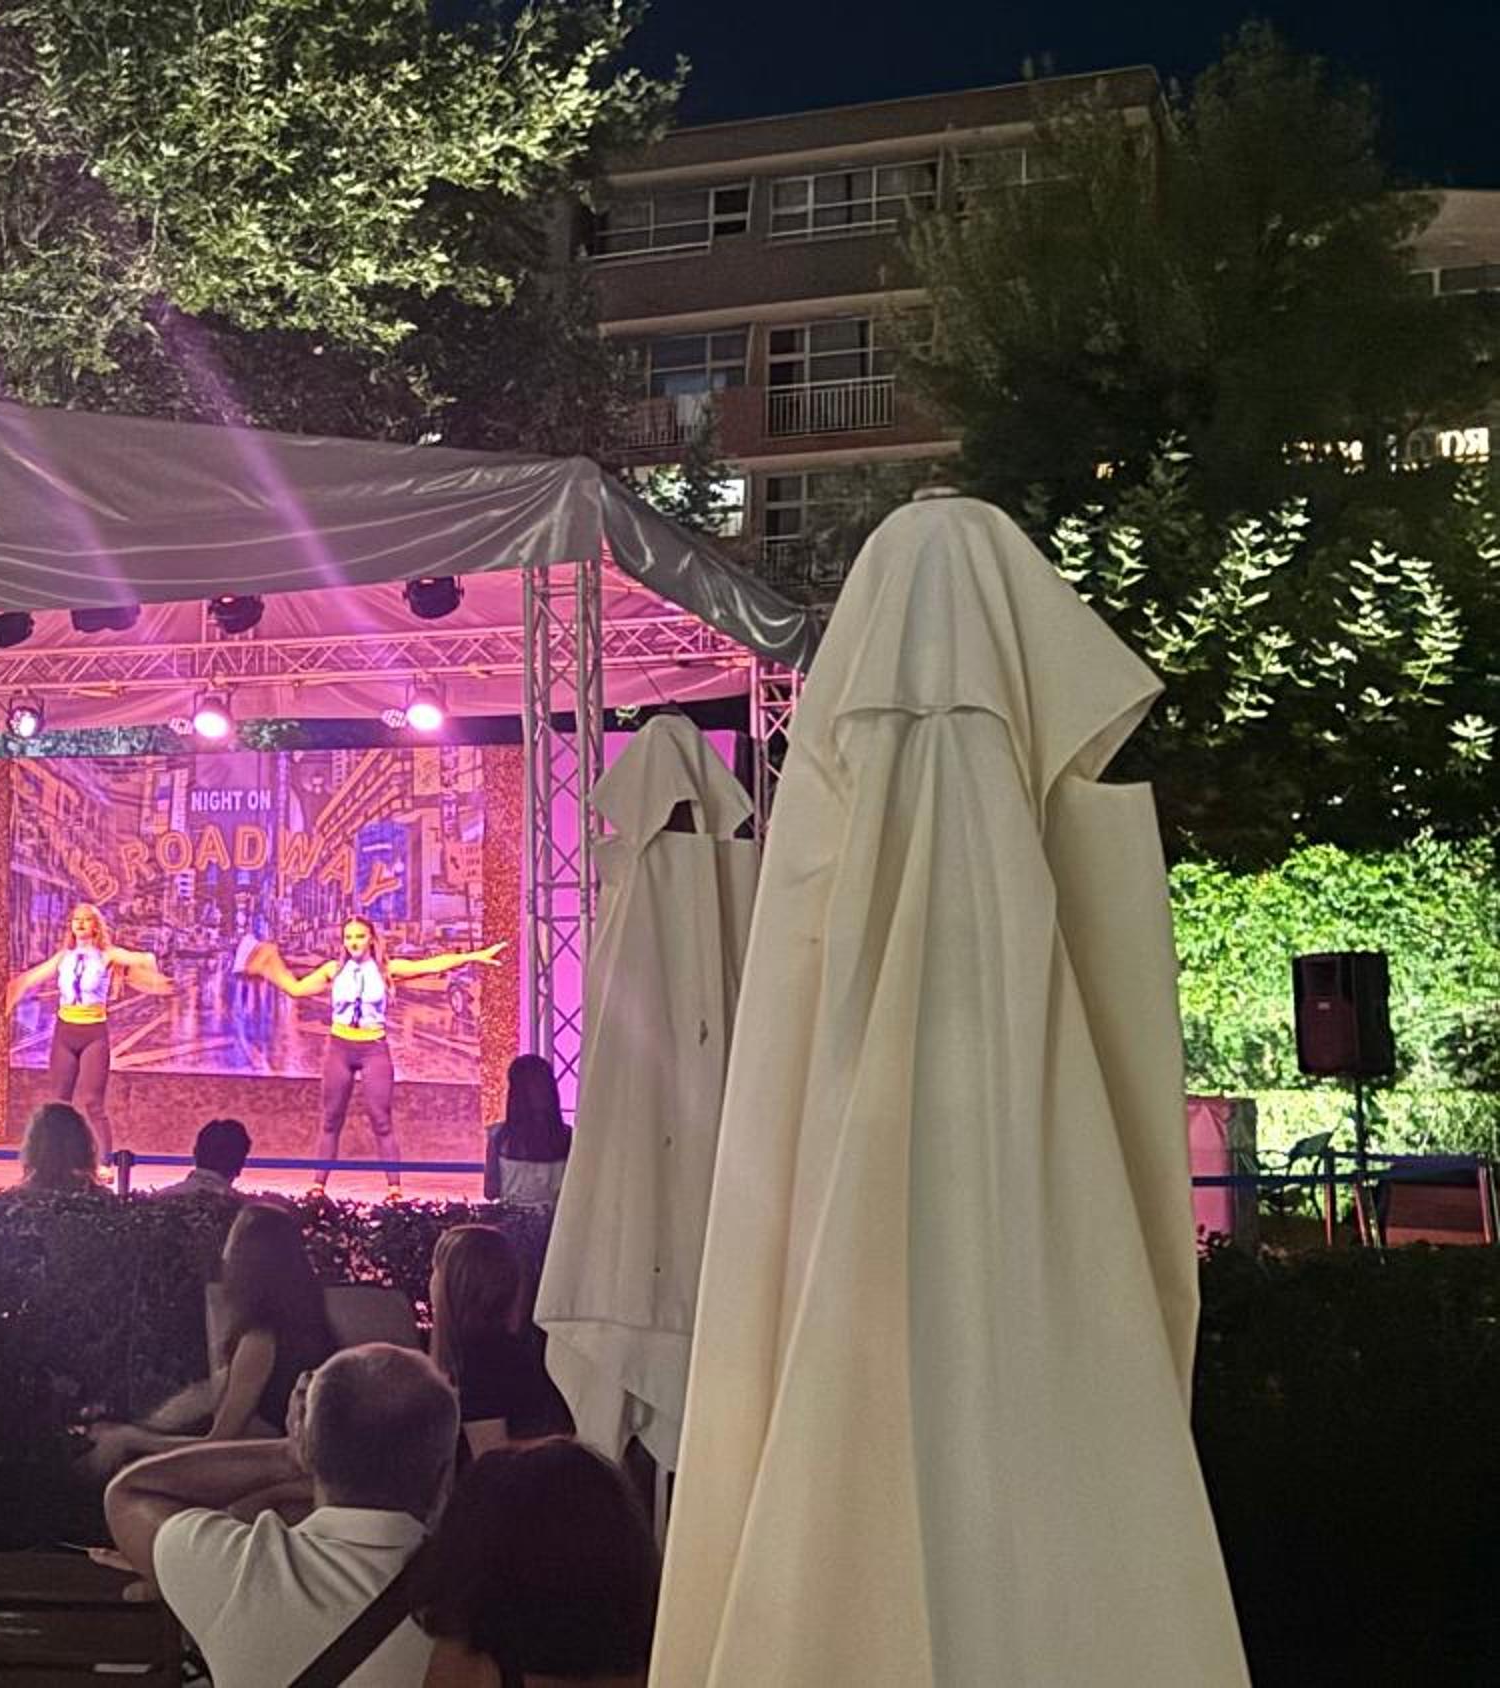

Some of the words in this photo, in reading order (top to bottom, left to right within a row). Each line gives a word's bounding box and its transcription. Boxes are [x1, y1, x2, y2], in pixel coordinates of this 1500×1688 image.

[192, 790, 241, 811] NIGHT
[248, 790, 271, 810] ON
[70, 823, 400, 905] BROADWAY
